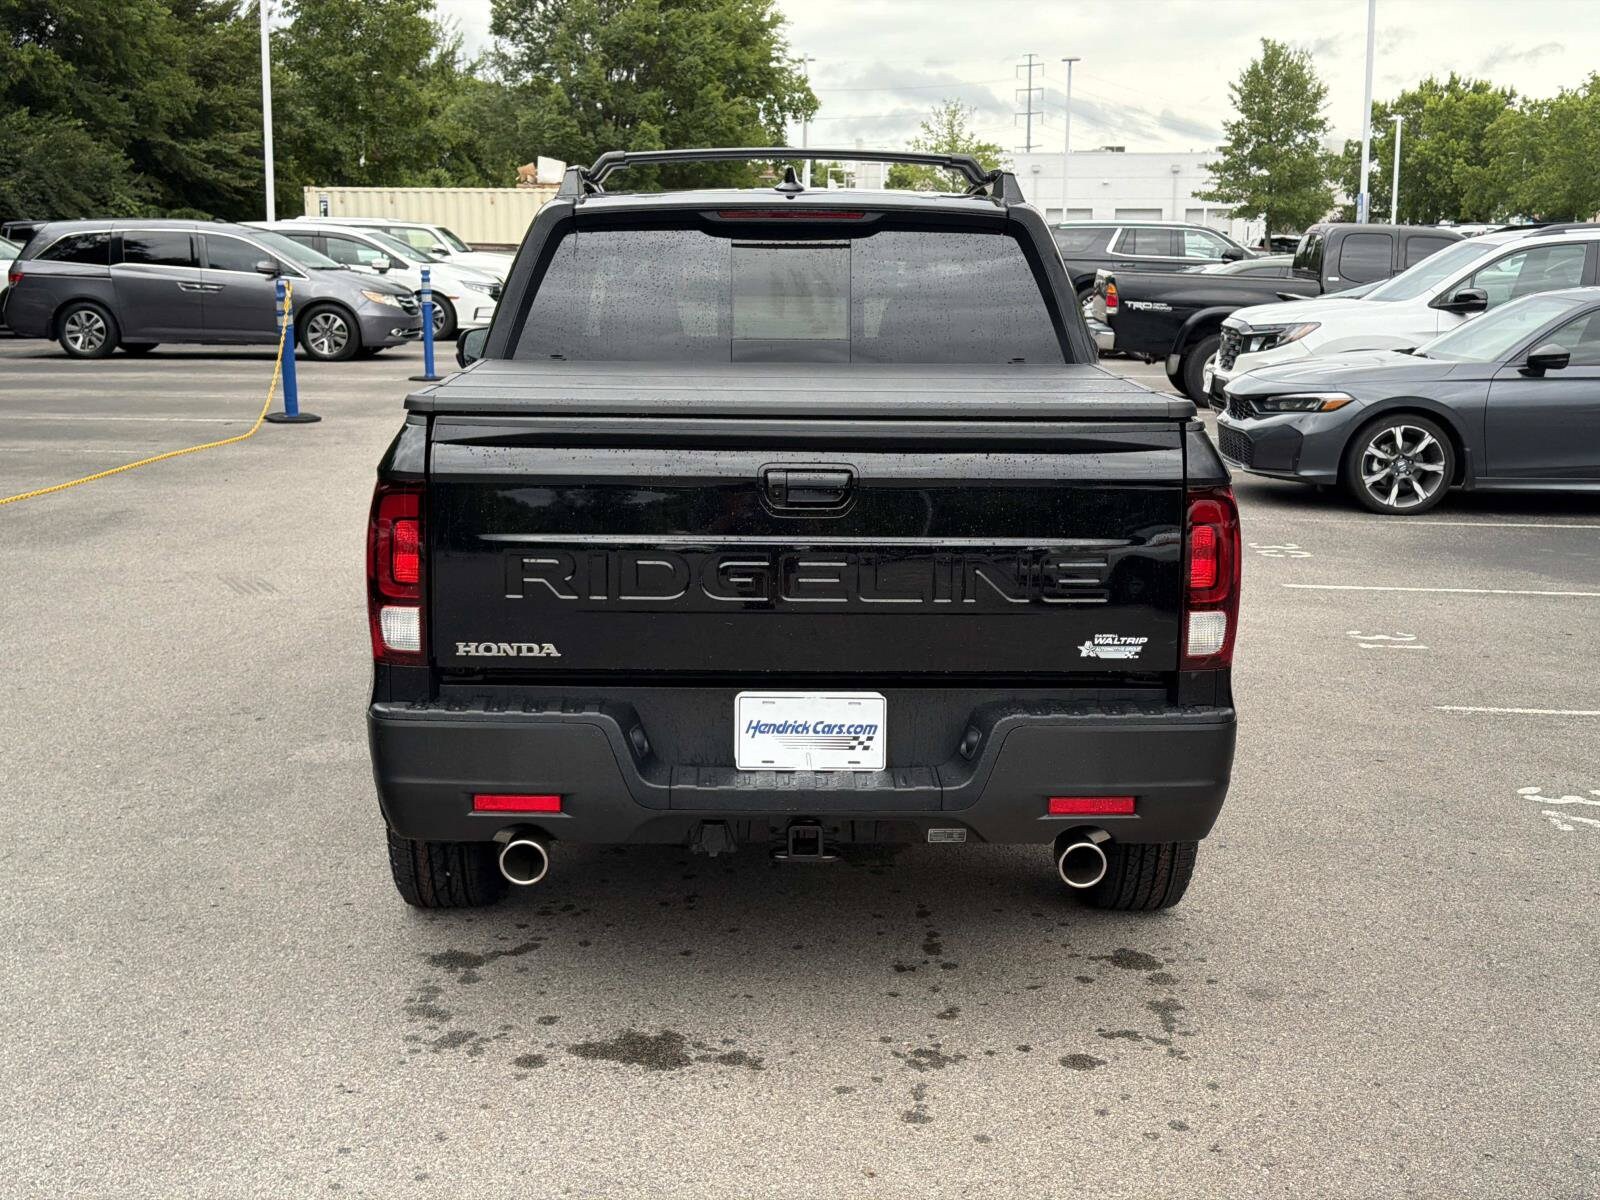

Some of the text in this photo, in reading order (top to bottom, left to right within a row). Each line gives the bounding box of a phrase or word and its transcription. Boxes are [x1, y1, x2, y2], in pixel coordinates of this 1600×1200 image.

[505, 552, 1109, 604] RIDGELINE
[1094, 637, 1148, 645] WALTRIP
[455, 642, 561, 657] HONDA
